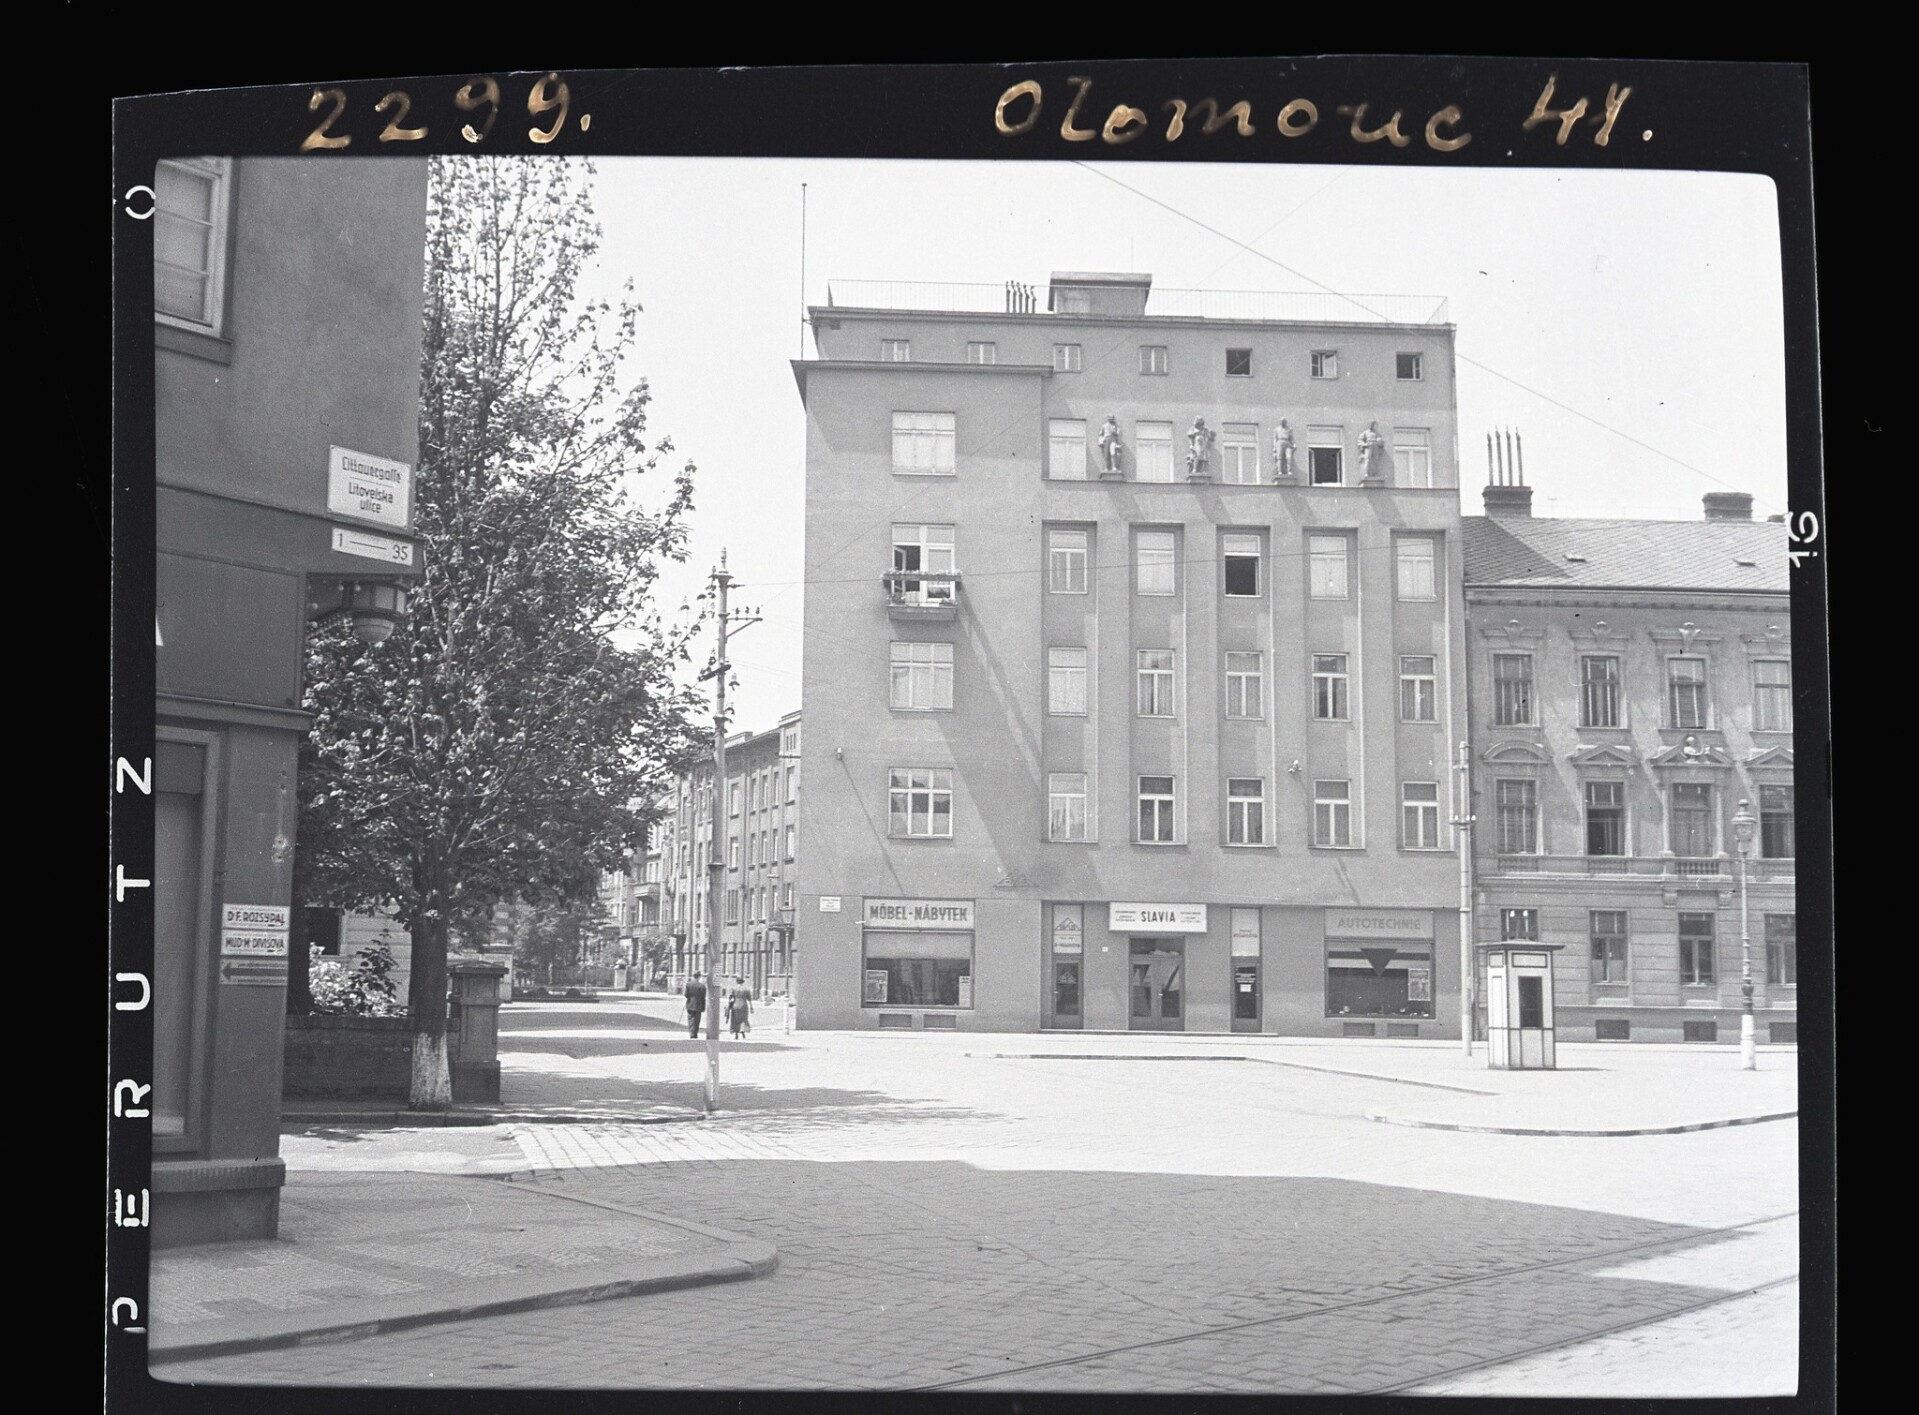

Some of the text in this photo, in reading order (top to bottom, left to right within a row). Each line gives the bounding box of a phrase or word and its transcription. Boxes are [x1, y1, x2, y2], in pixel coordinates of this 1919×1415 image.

[995, 76, 1473, 152] Olomouc
[359, 499, 382, 514] ulice
[391, 544, 409, 561] 35
[1140, 910, 1176, 923] SLAVIA
[111, 756, 153, 1335] PERUTZ
